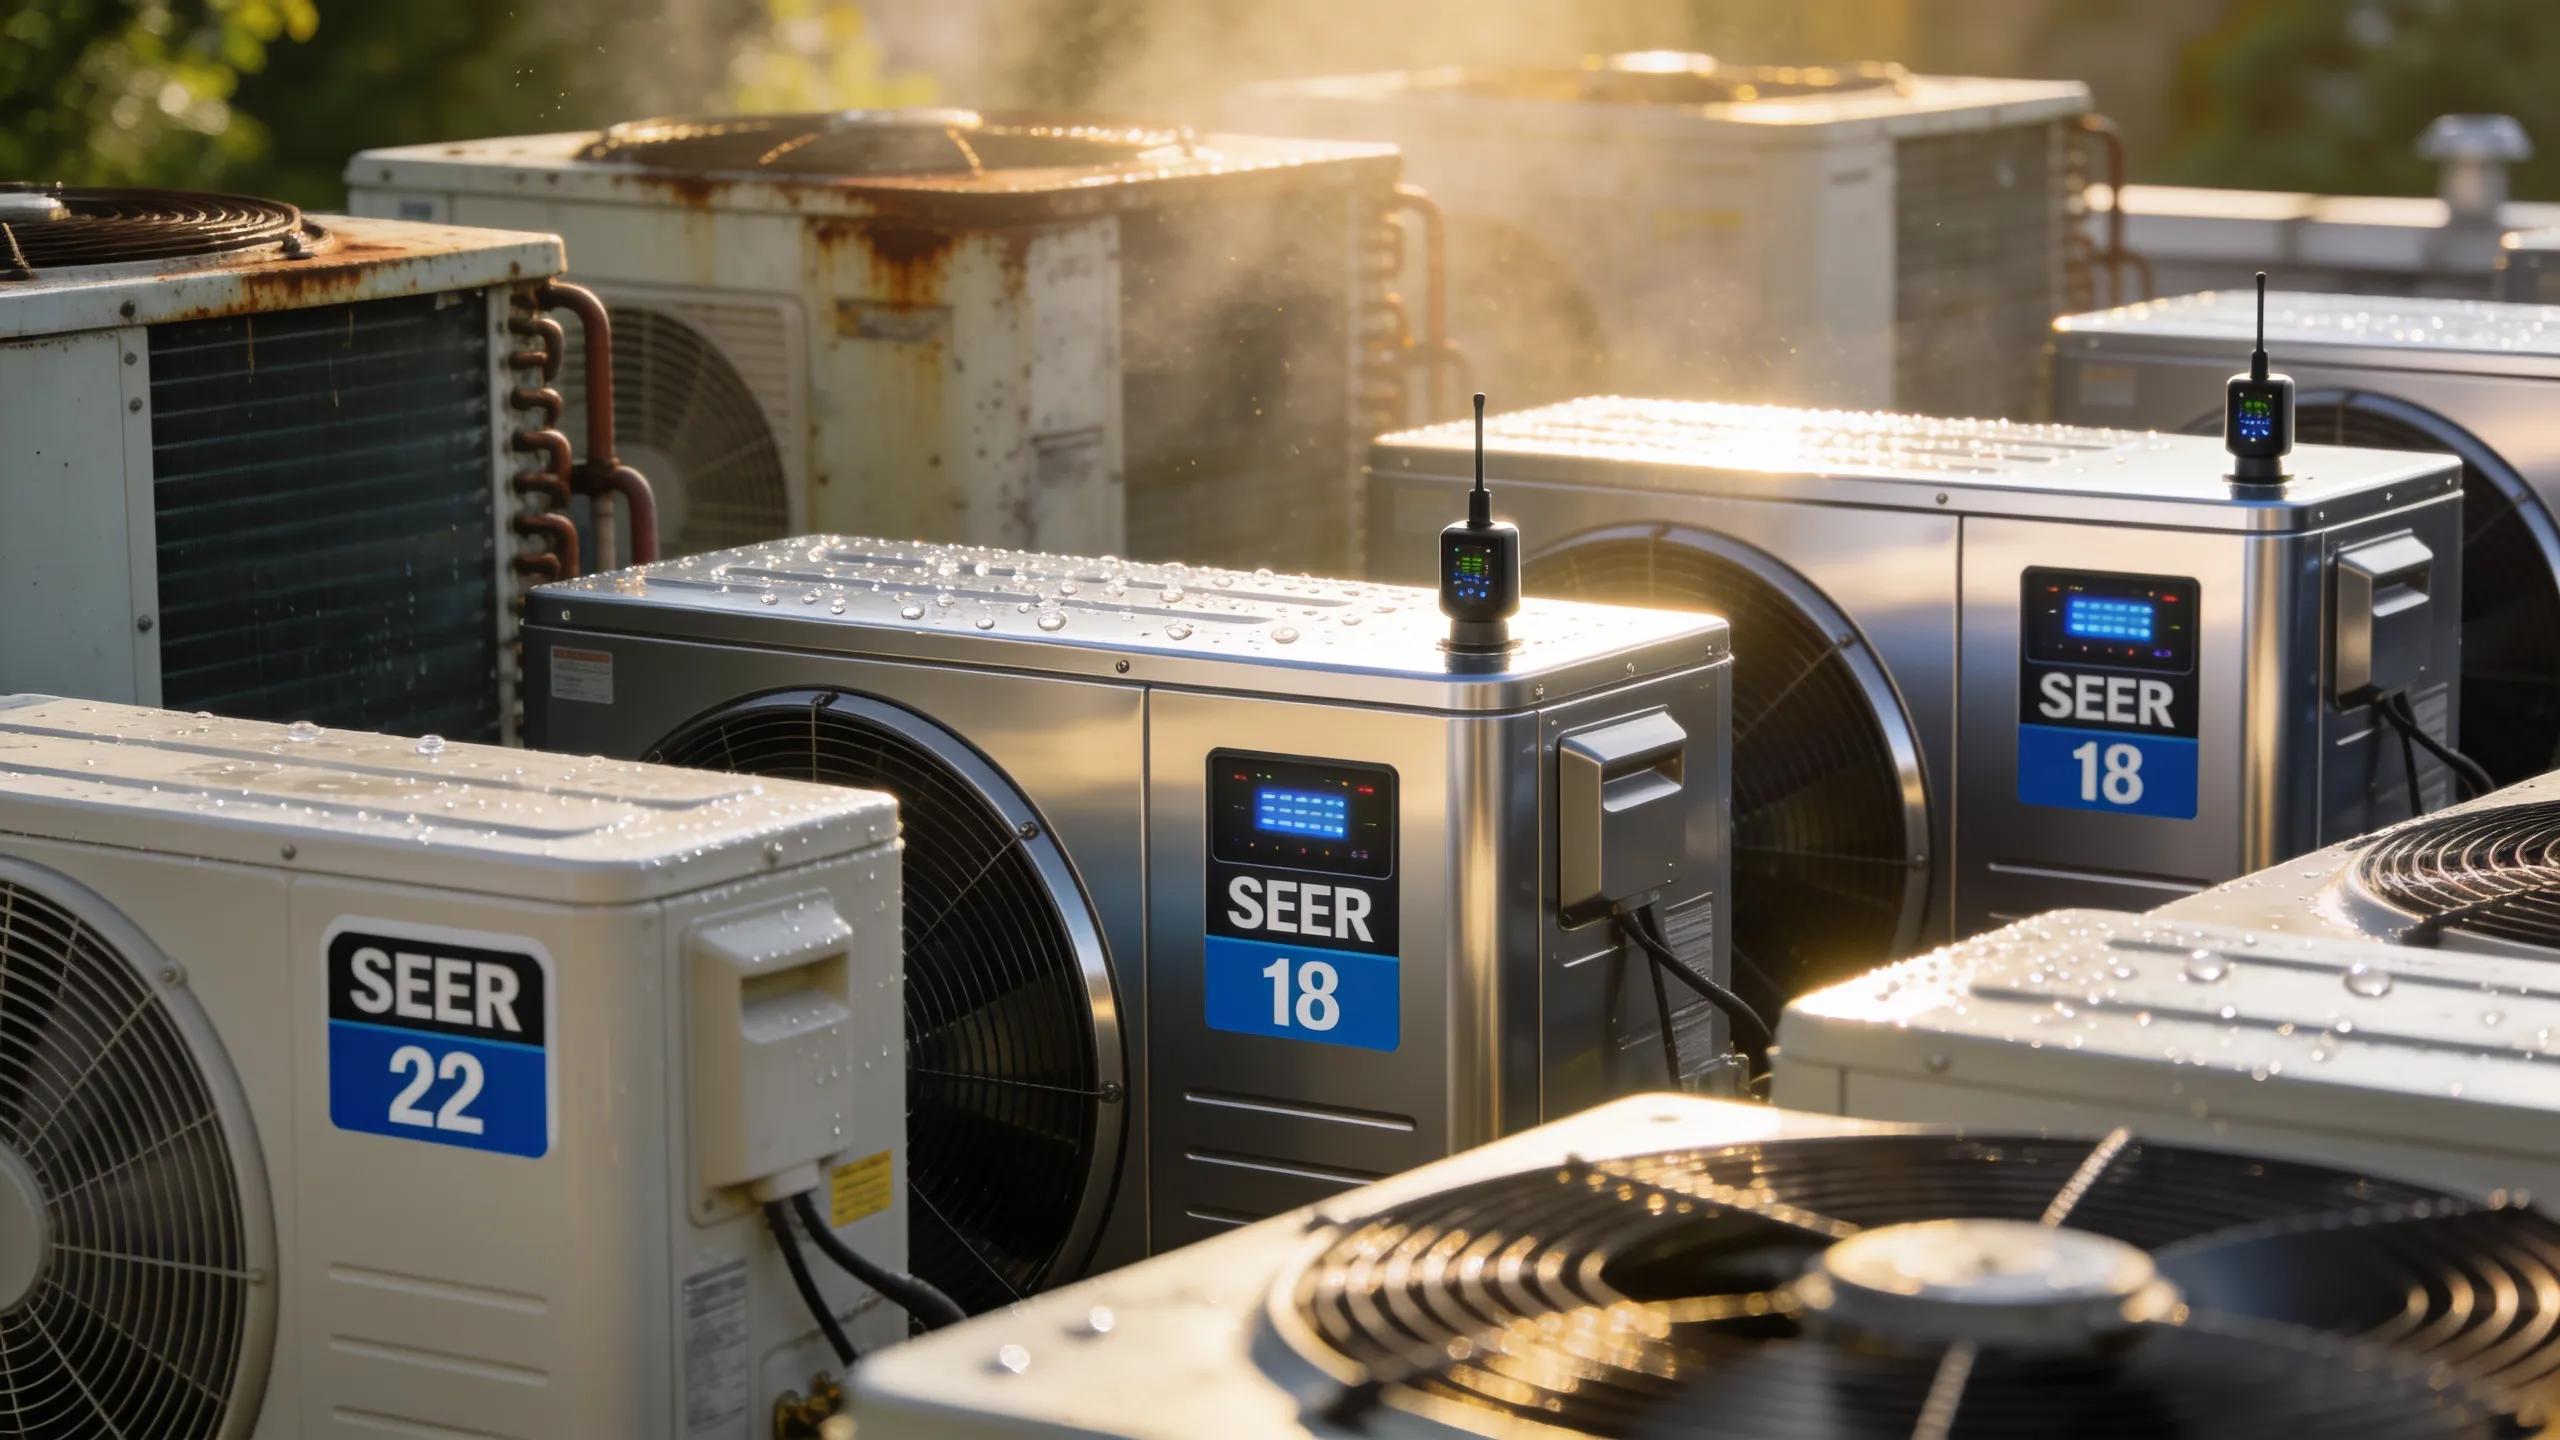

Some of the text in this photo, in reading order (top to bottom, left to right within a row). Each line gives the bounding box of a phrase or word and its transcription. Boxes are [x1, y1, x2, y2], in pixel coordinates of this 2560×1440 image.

[2038, 672, 2175, 729] SEER
[2073, 740, 2144, 806] 18
[1227, 875, 1374, 944] SEER
[349, 946, 523, 1033] SEER
[1262, 957, 1340, 1032] 18
[388, 1045, 485, 1135] 22
